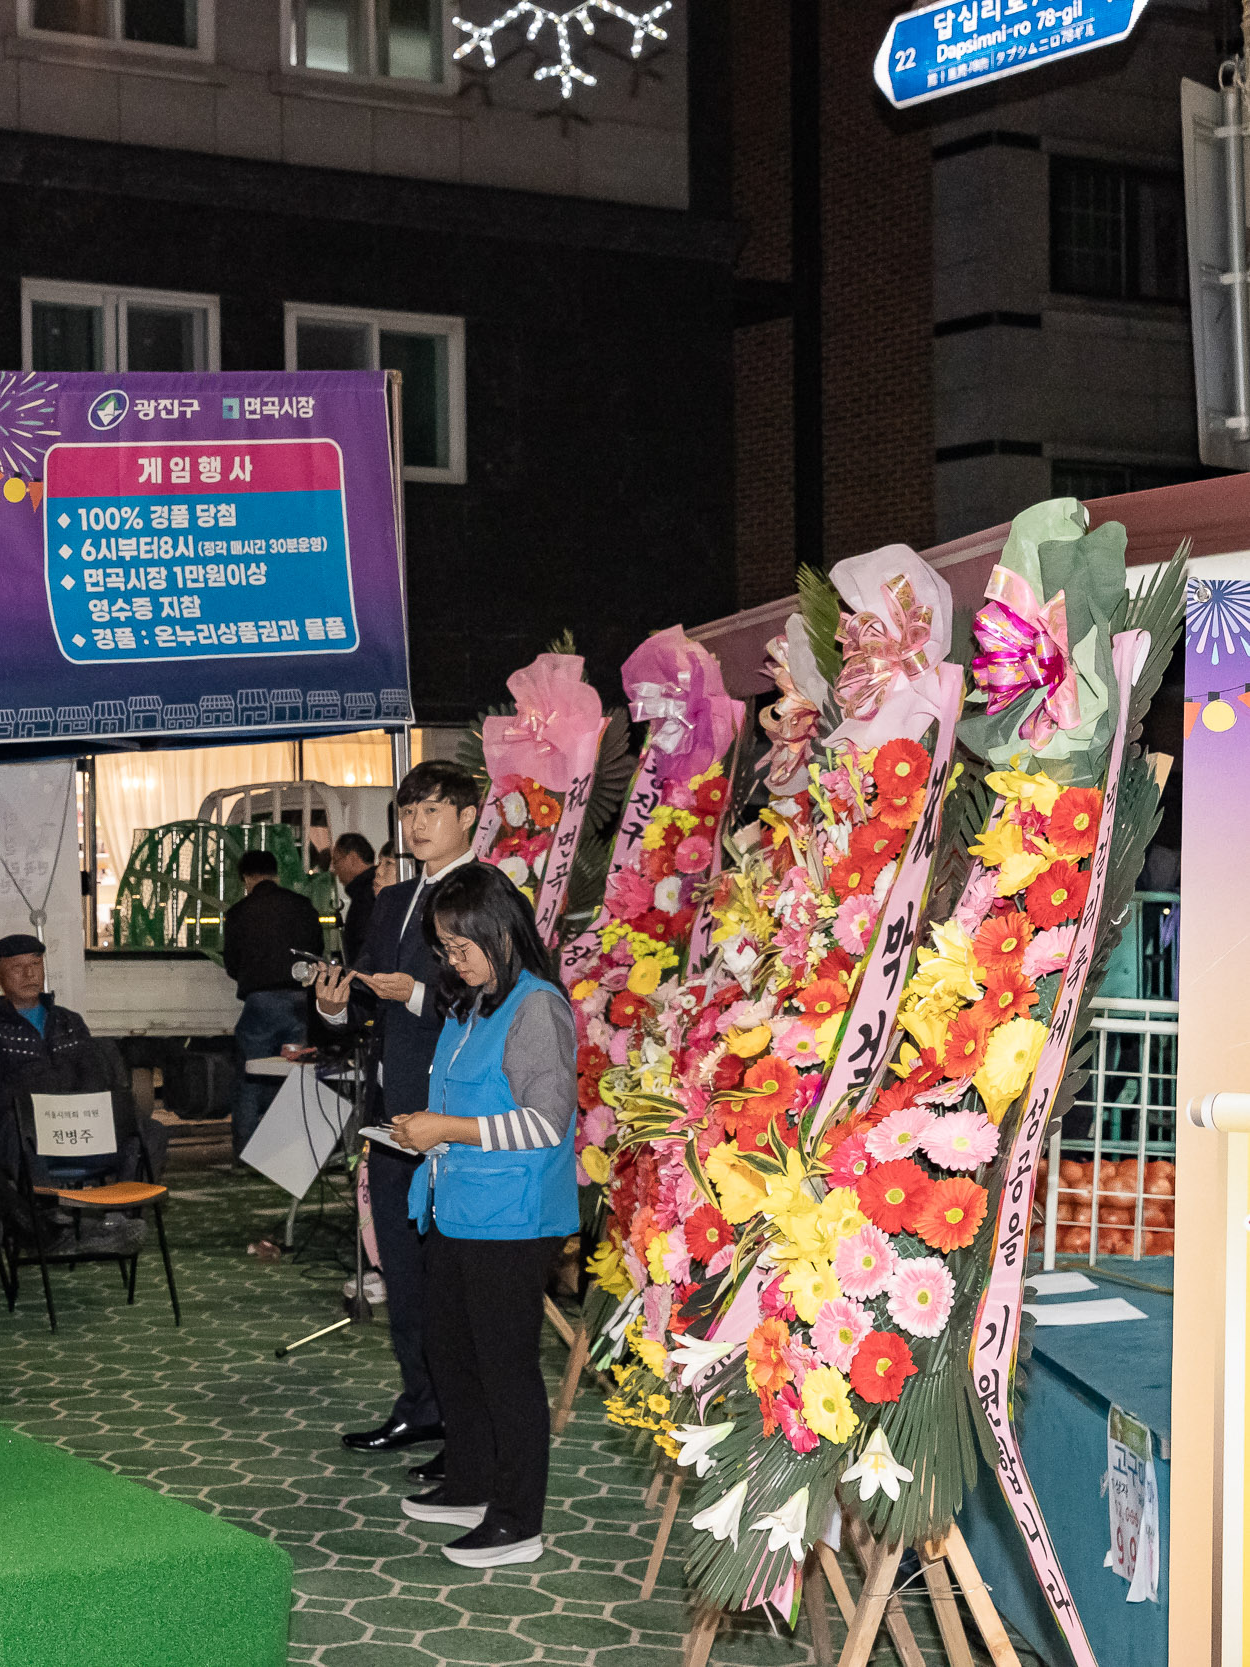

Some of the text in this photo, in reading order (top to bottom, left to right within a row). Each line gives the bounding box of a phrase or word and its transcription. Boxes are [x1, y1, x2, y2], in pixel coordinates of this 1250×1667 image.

[933, 0, 1038, 42] 답십리로
[936, 0, 1083, 63] Dapsimni-ro 78-gil
[894, 47, 917, 73] 22
[134, 398, 201, 421] 광진구
[244, 396, 316, 420] 면곡시장
[138, 455, 253, 485] 게임행사
[78, 502, 238, 532] 100% 경품 당첨
[80, 535, 328, 562] 6시부터8시 (정각 매시간 30분운영)
[83, 563, 268, 593] 면곡시장 1만원이상
[88, 594, 202, 623] 영수증 지참
[91, 627, 137, 651] 경품
[154, 618, 300, 649] 온누리상품권과
[304, 616, 348, 641] 물품
[51, 1129, 94, 1145] 전병주
[1000, 1087, 1050, 1267] 성공을
[979, 1303, 1075, 1628] 기원합니다
